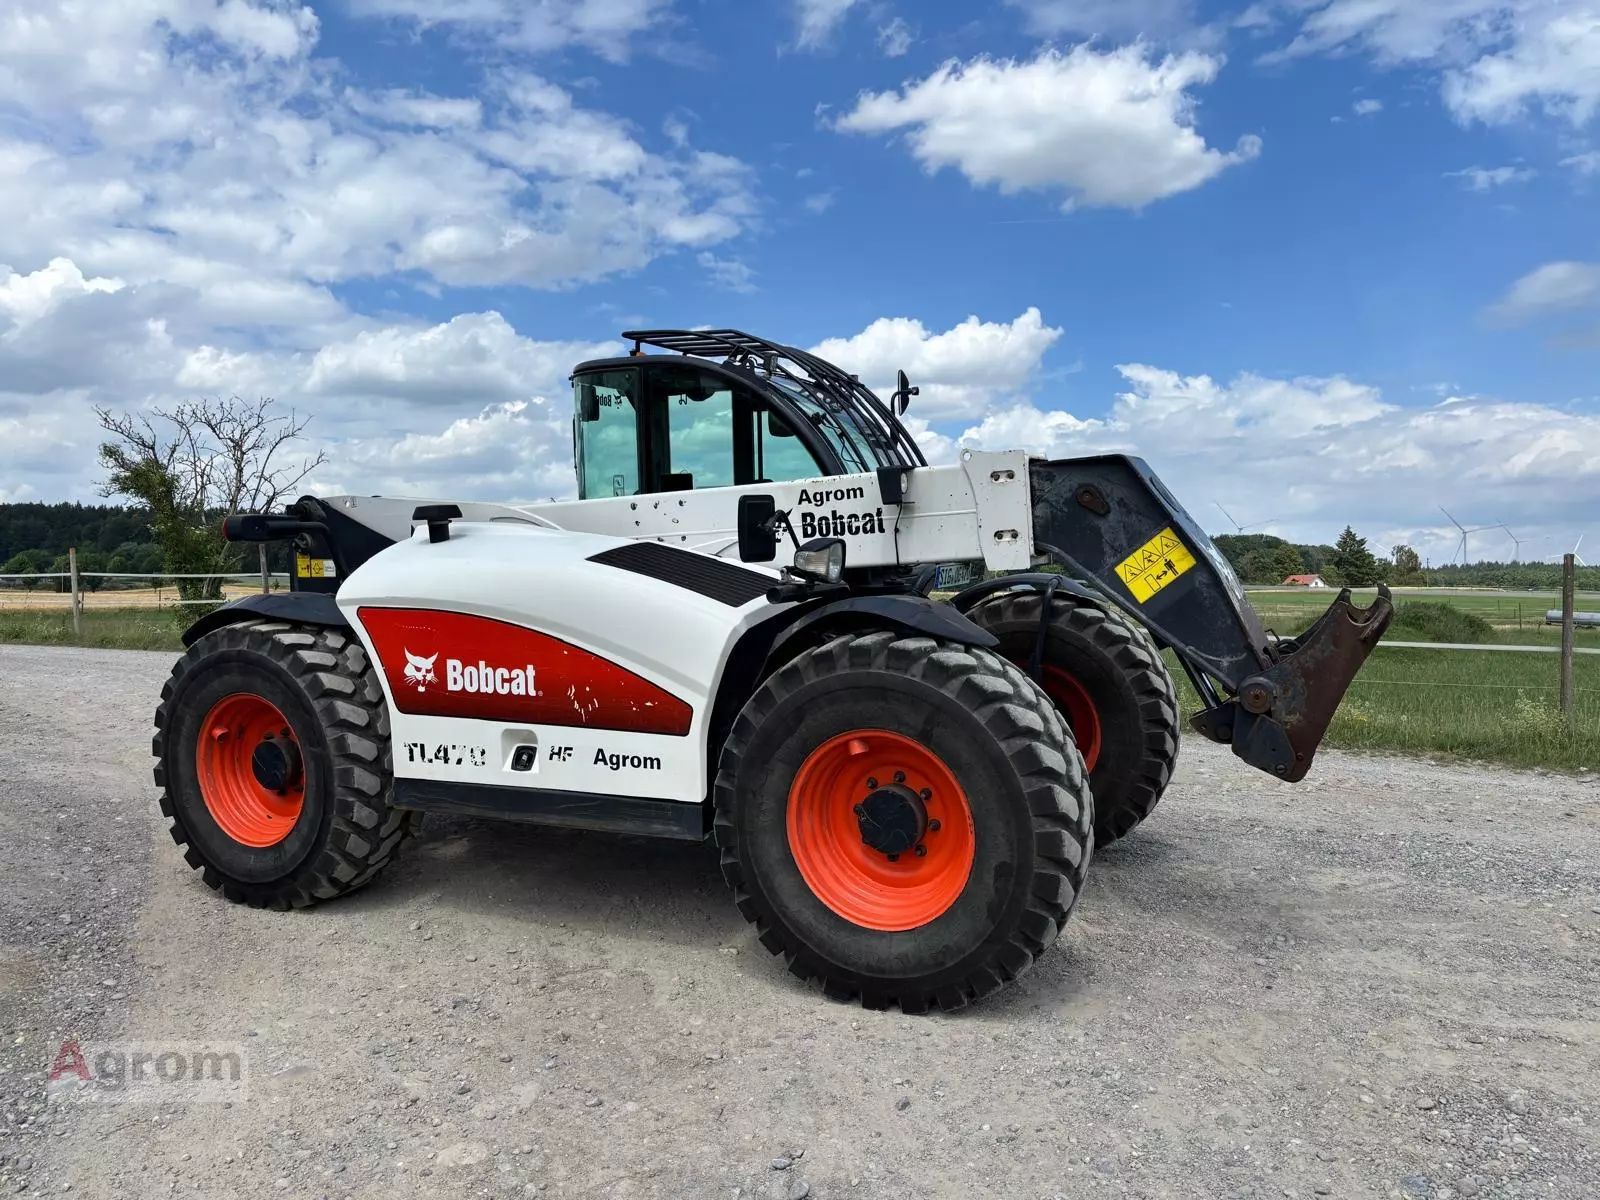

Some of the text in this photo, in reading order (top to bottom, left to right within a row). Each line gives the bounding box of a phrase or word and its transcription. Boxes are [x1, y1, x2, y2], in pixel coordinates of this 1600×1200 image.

[798, 487, 864, 507] Agrom
[801, 507, 885, 538] Bobcat
[446, 658, 537, 697] Bobcat
[548, 745, 574, 762] HF
[593, 747, 661, 771] Agrom
